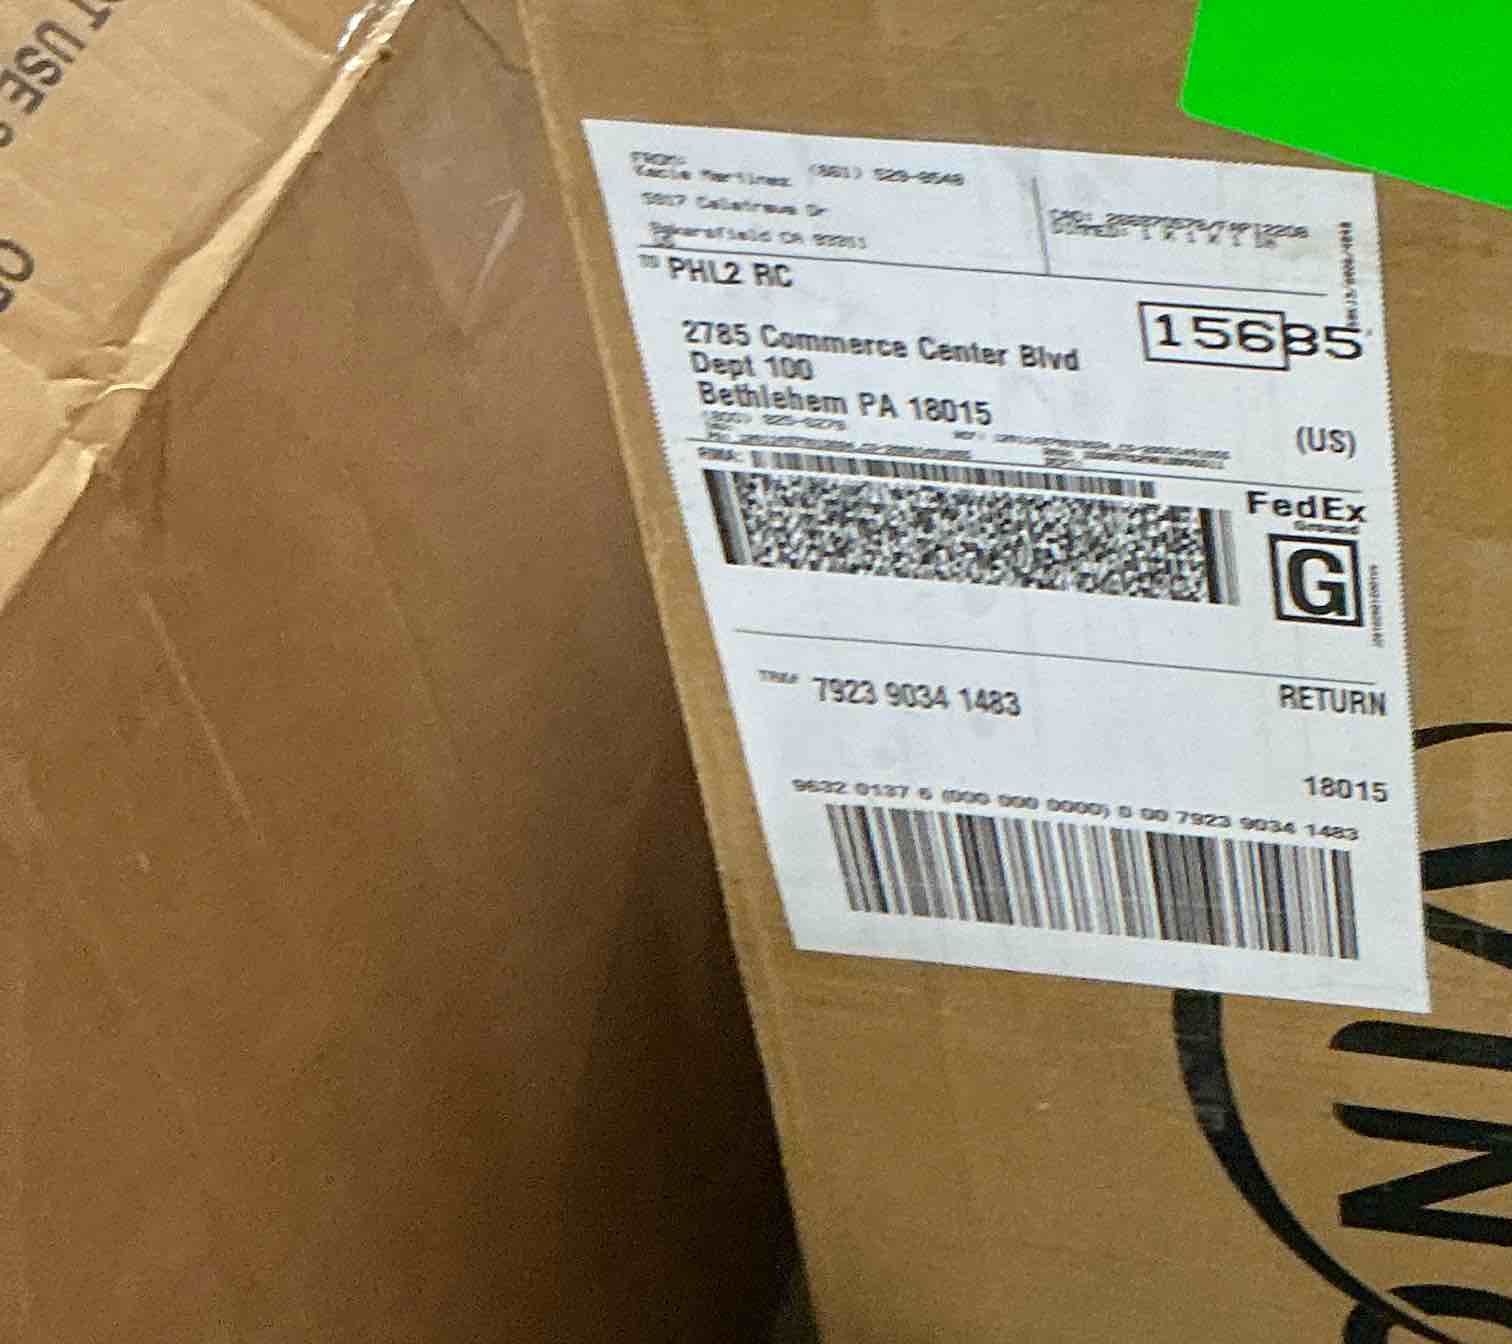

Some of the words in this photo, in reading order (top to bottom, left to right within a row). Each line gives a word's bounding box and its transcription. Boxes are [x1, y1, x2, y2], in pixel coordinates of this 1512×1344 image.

[0, 19, 87, 115] USE
[668, 257, 743, 284] PHL2
[753, 263, 794, 288] RC
[681, 319, 751, 347] 2785
[759, 324, 908, 358] Commerce
[917, 335, 1009, 366] Center
[1019, 344, 1080, 372] Blvd
[689, 350, 756, 380] Dept
[765, 355, 815, 381] 100
[697, 381, 849, 414] Bethlehem
[857, 391, 899, 419] PA
[907, 395, 993, 426] 18015
[1296, 425, 1357, 459] (US)
[1246, 490, 1368, 524] FedEx
[1287, 548, 1347, 617] G
[812, 677, 877, 706] 7923
[884, 681, 949, 709] 9034
[957, 687, 1021, 717] 1483
[1278, 683, 1387, 717] RETURN
[1303, 774, 1389, 803] 18015
[1139, 807, 1169, 822] 00
[1176, 810, 1233, 829] 7923
[1239, 816, 1297, 835] 9034
[1303, 823, 1360, 842] 1483
